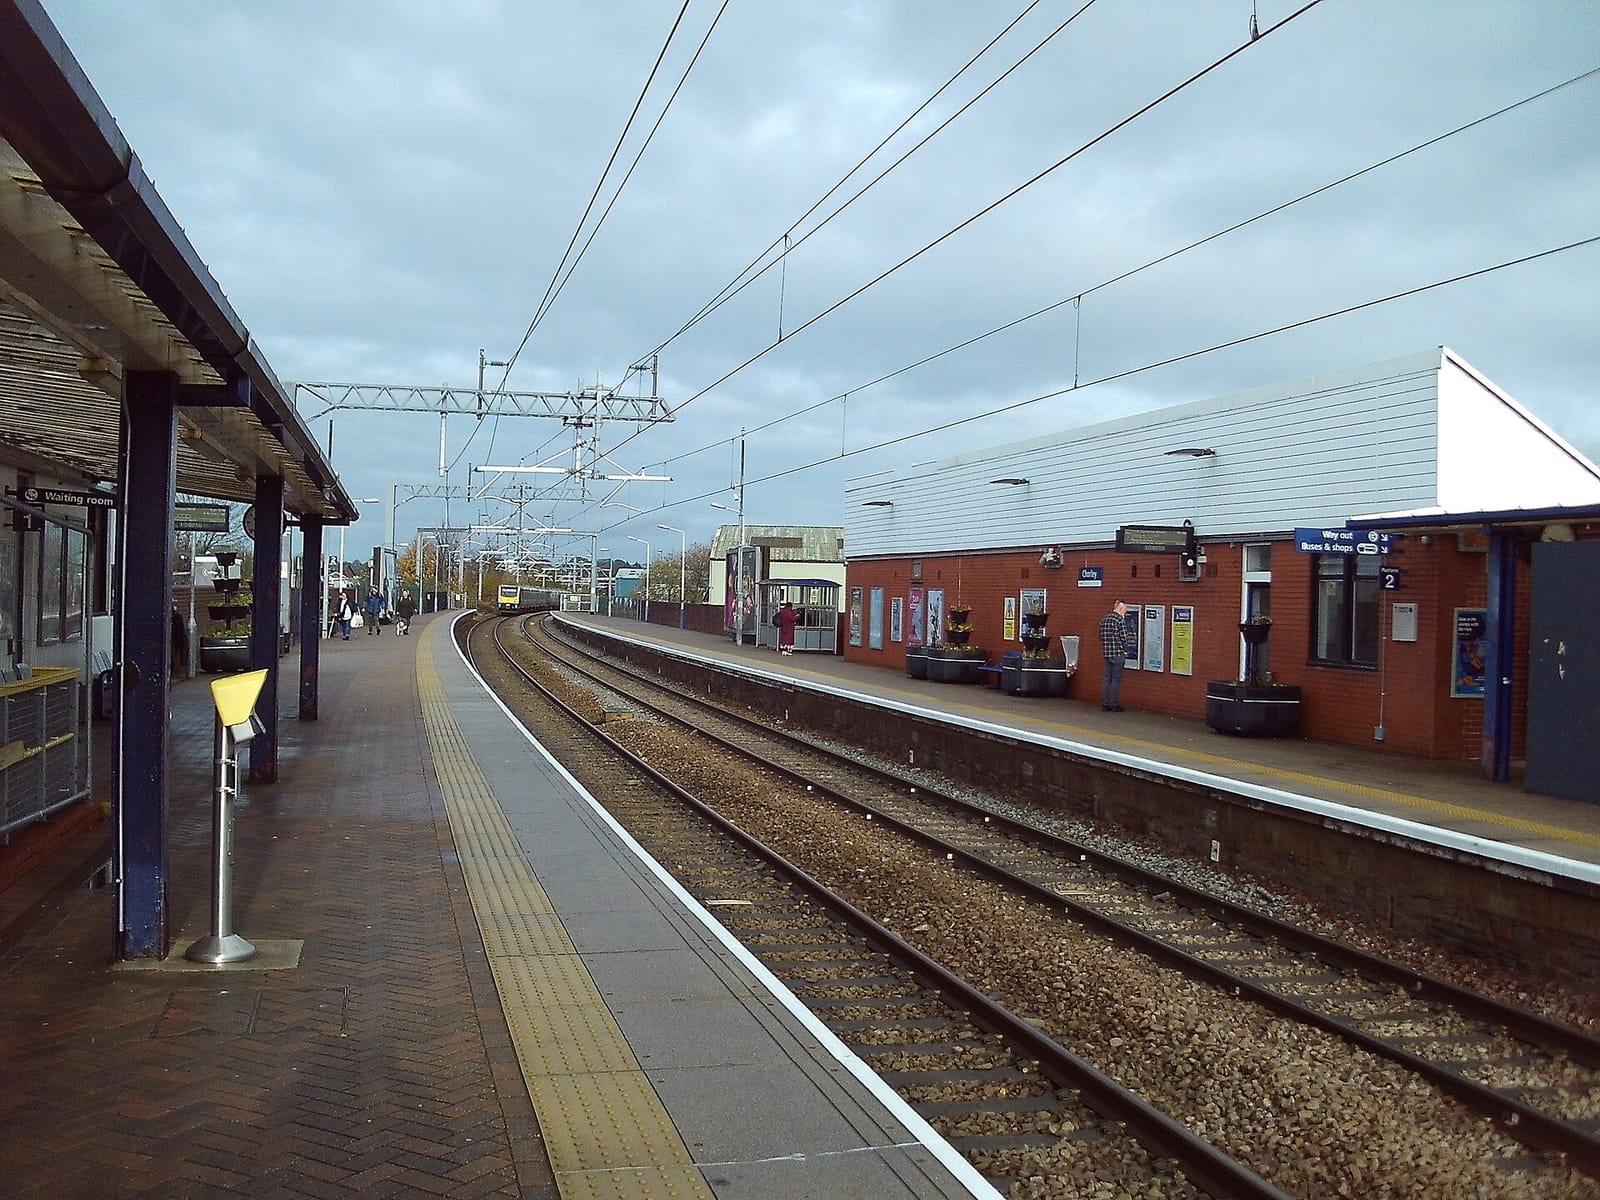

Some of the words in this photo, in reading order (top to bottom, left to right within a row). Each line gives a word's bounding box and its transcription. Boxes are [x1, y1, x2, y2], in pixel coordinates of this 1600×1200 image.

[45, 491, 83, 505] Waiting
[87, 497, 114, 506] room
[23, 513, 31, 529] 1
[1322, 530, 1338, 540] Way
[1339, 532, 1353, 540] out
[1301, 541, 1322, 551] Buses
[1324, 542, 1331, 551] &
[1331, 542, 1353, 553] shops
[1385, 574, 1394, 588] 2
